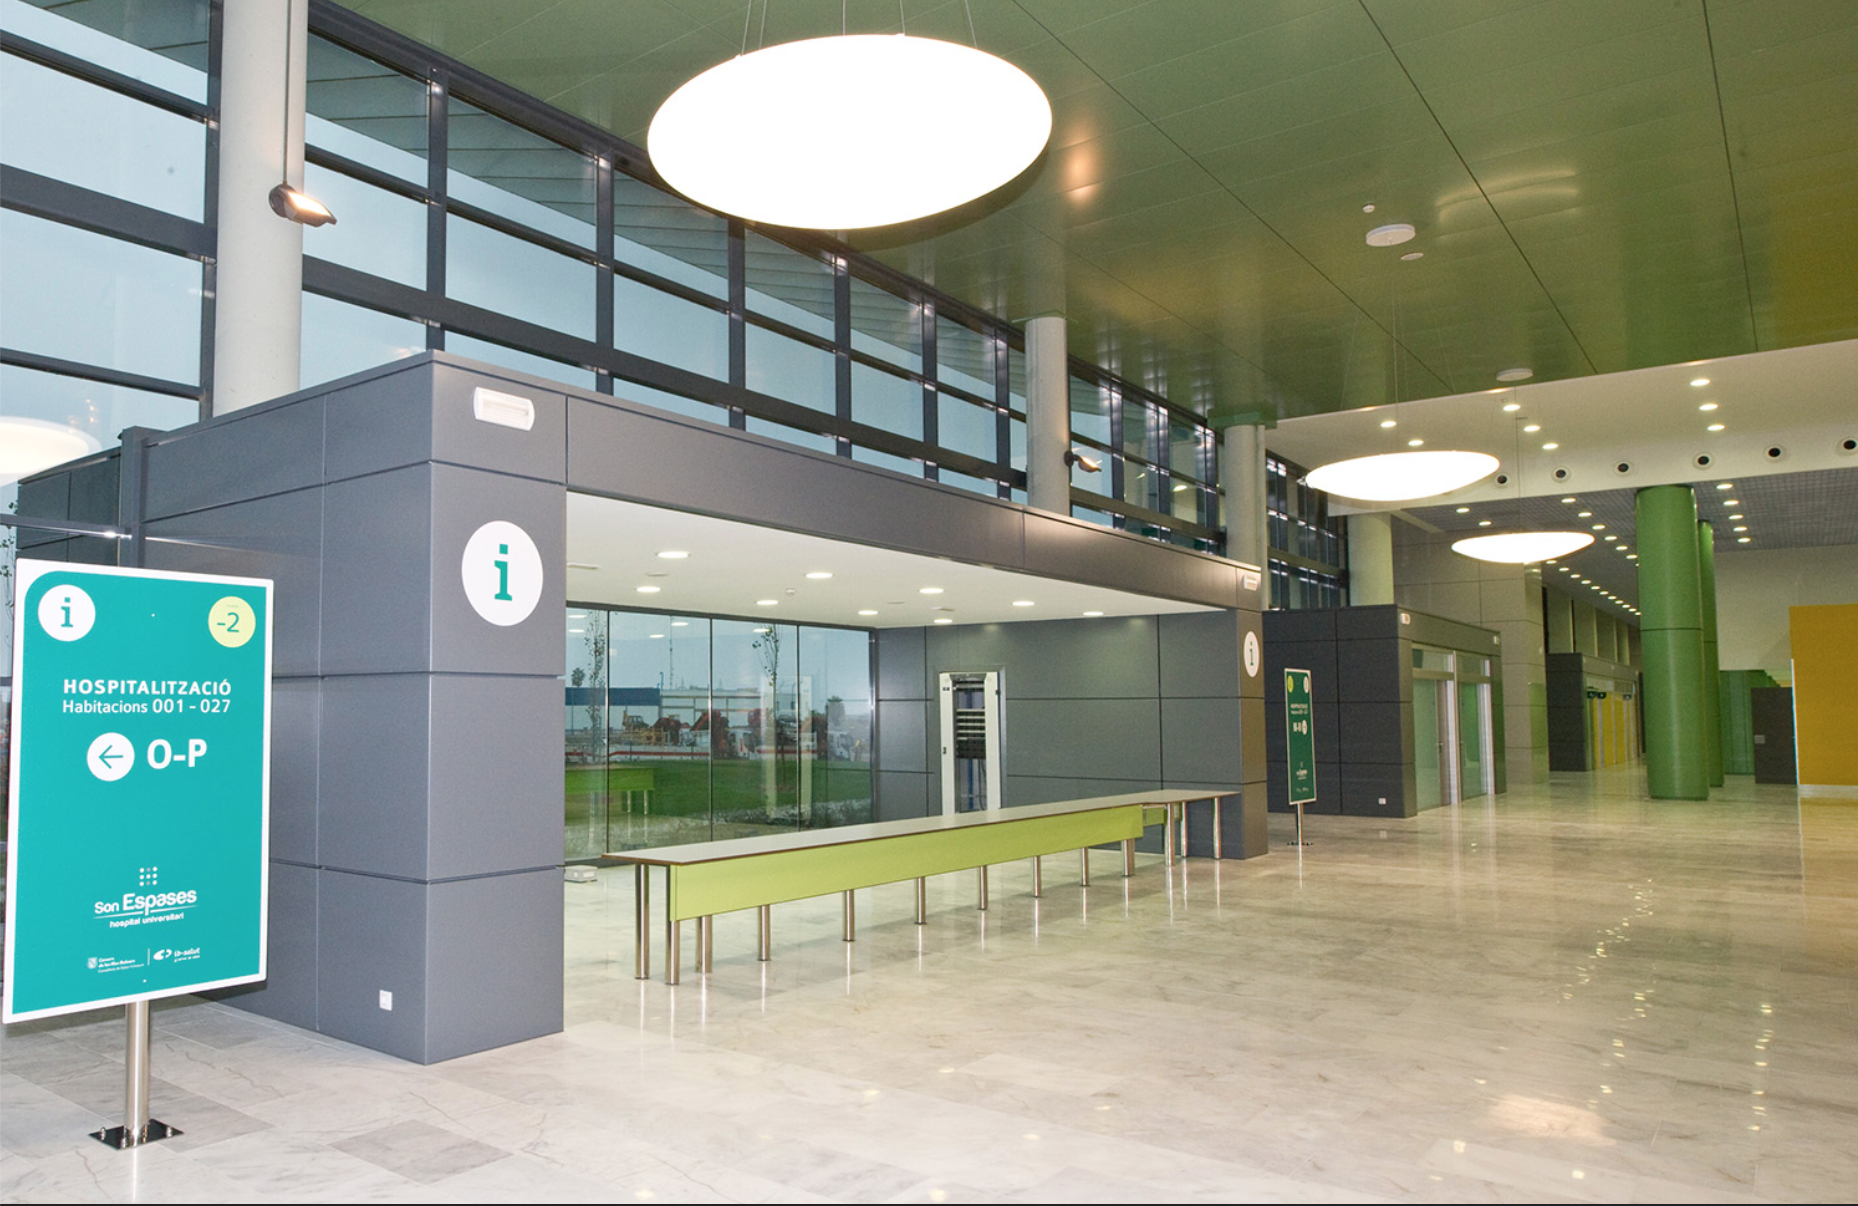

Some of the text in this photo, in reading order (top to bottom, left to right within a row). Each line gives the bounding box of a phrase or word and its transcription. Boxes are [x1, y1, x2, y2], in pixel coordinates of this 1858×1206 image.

[494, 543, 513, 601] i
[61, 597, 74, 628] i
[216, 612, 240, 633] -2
[63, 679, 232, 696] HOSPITALITZACIÓ
[62, 699, 148, 714] Habitacions
[152, 698, 184, 713] 001
[200, 699, 231, 713] 027
[147, 738, 208, 770] O-P
[94, 889, 197, 916] Son Espases
[109, 912, 184, 928] hospital universitari
